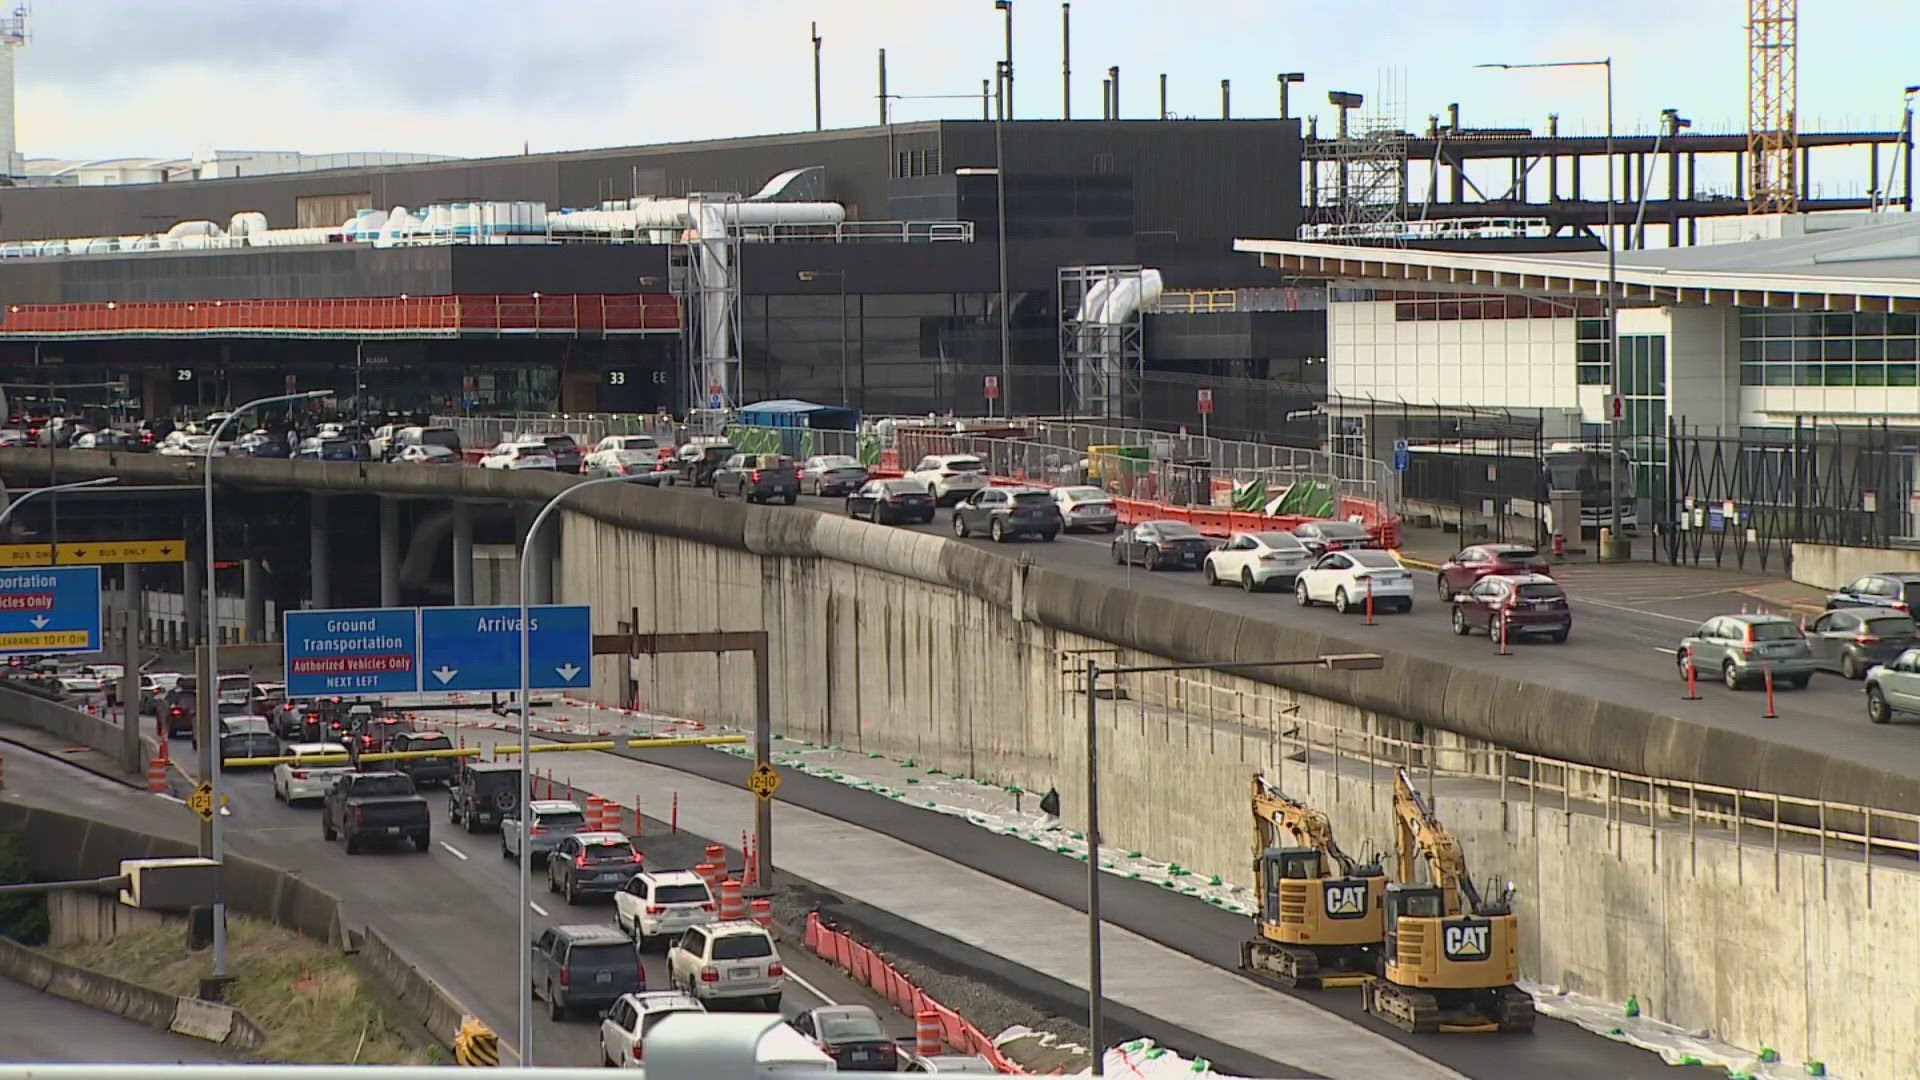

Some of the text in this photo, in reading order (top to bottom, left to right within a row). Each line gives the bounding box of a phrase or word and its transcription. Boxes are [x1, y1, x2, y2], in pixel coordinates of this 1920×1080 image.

[177, 369, 192, 381] 29
[609, 371, 625, 385] 33
[12, 551, 31, 559] BUS
[99, 548, 147, 557] BUS ONLY
[27, 595, 53, 609] Only
[327, 617, 376, 632] Ground
[477, 615, 538, 632] Arrivas
[303, 635, 402, 654] Transportation
[294, 656, 411, 673] Authorized Vehicles Only
[326, 675, 379, 688] NEXT LEFT
[191, 795, 212, 808] 12-1
[1327, 886, 1366, 914] CAT
[1446, 926, 1489, 955] CAT
